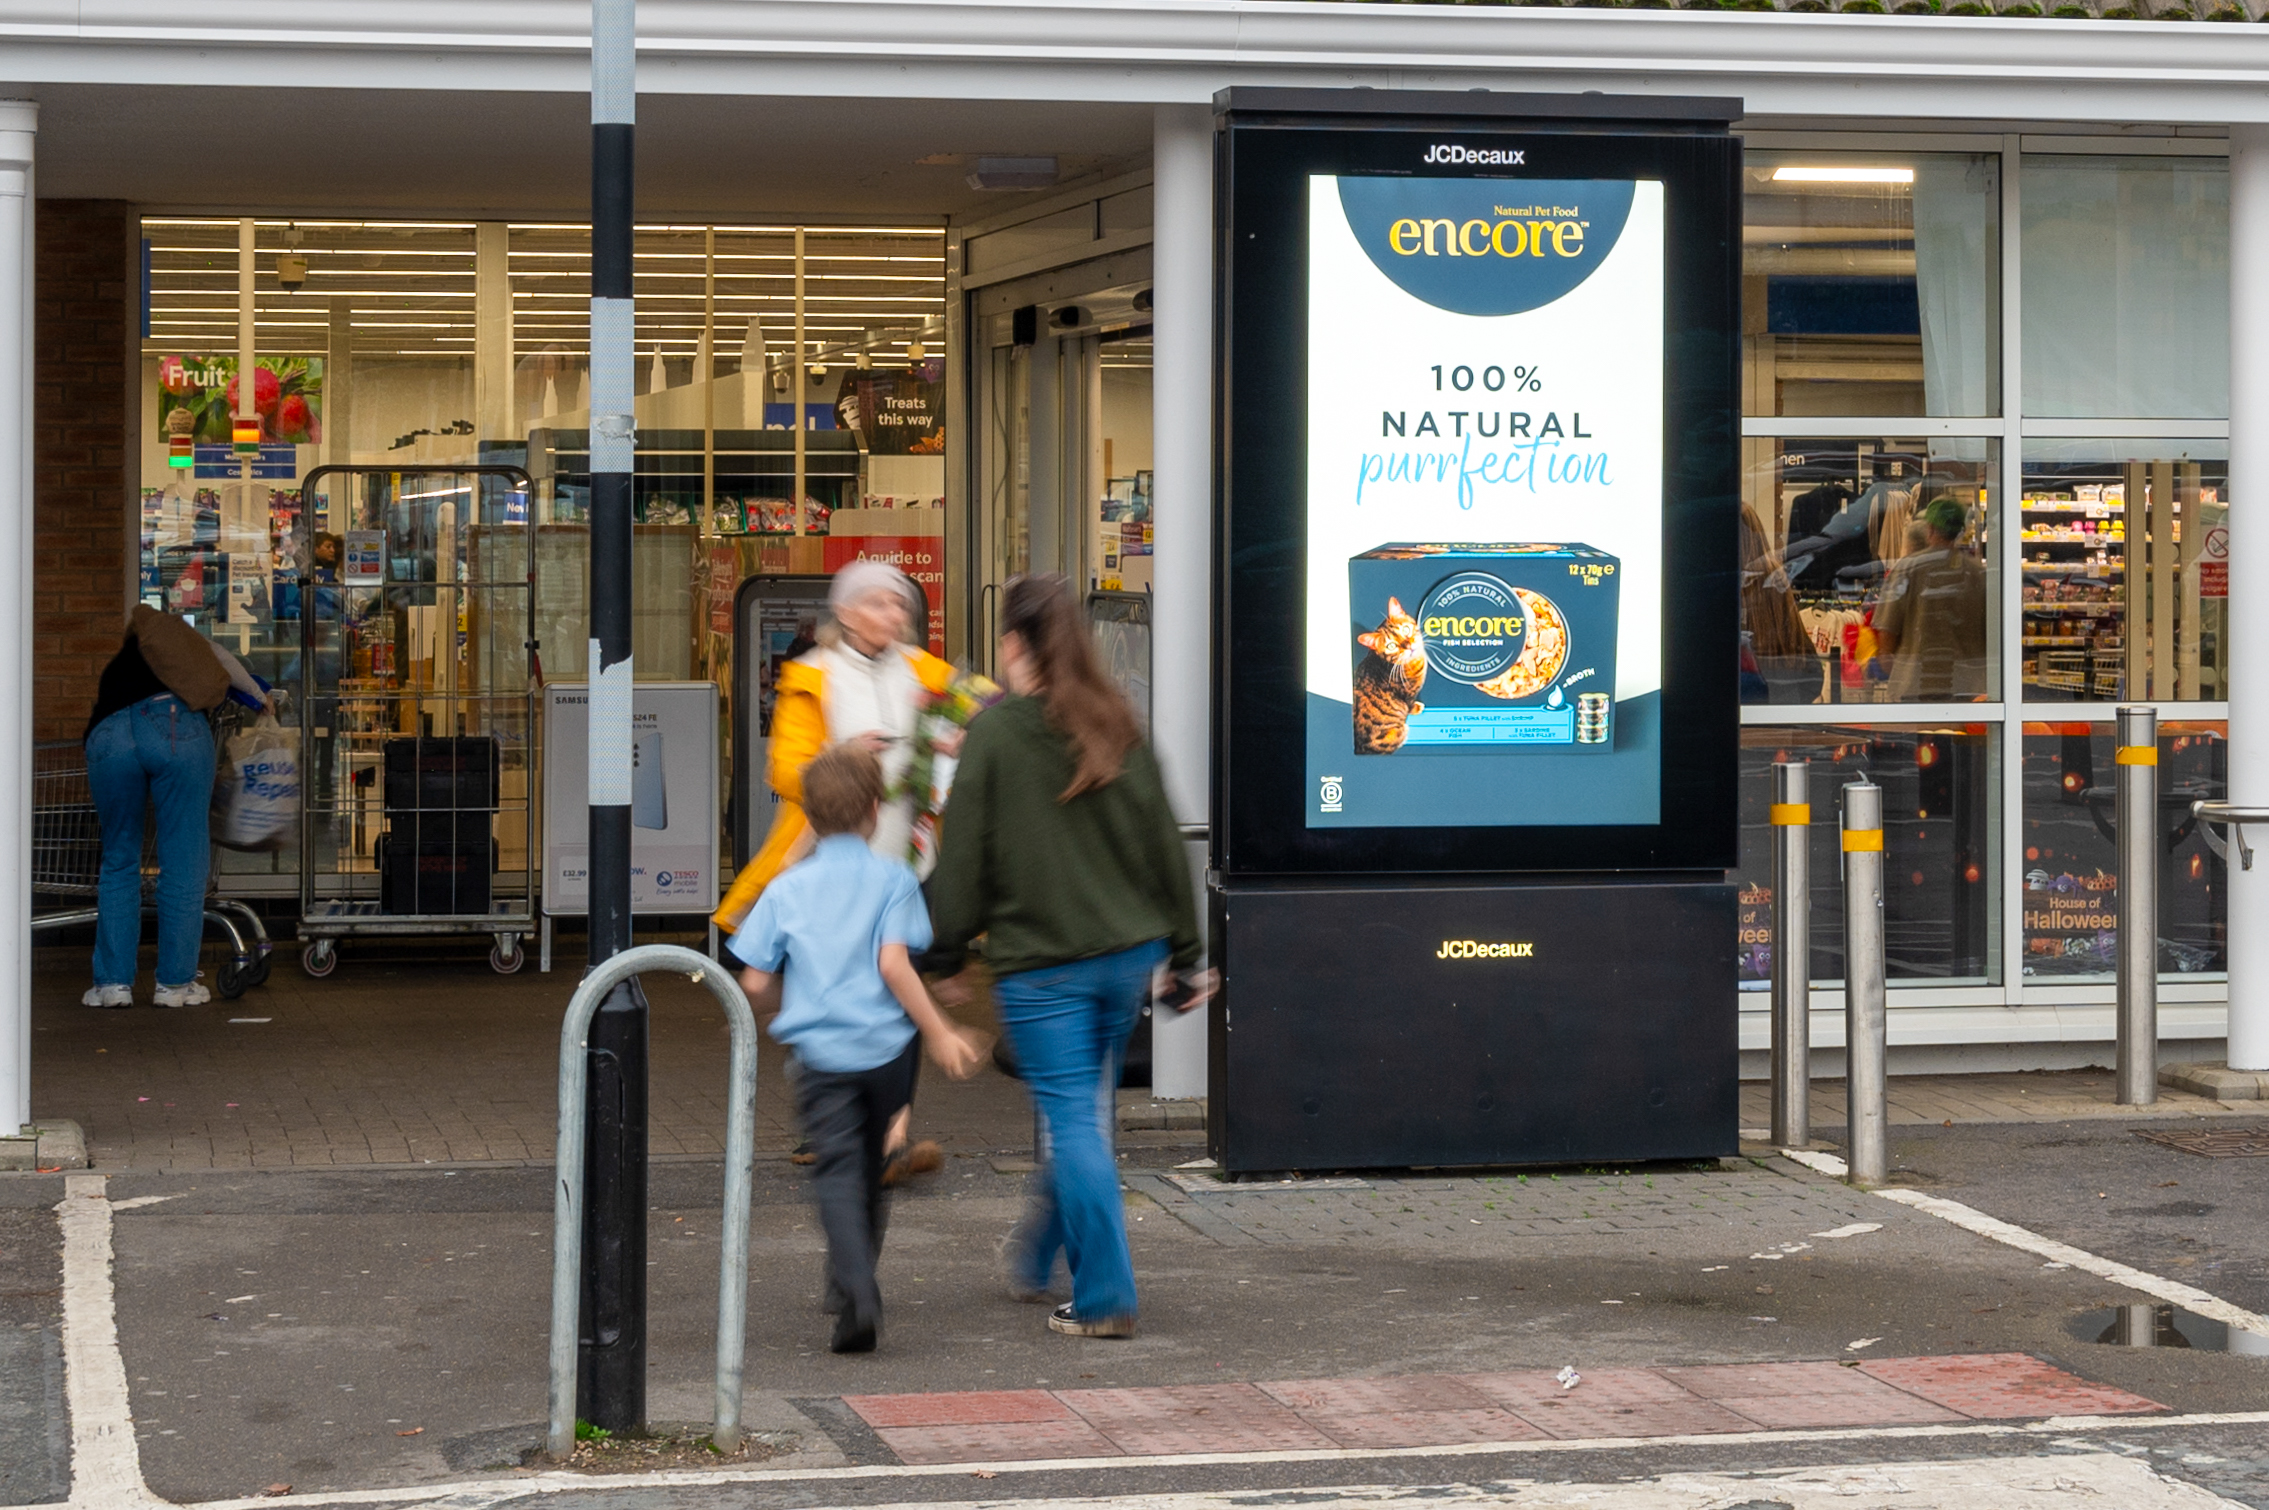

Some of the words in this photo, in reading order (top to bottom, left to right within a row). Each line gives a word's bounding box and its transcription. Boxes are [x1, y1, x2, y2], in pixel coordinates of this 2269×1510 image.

[1424, 145, 1525, 165] JCDecaux
[1494, 205, 1532, 216] Natural
[1535, 207, 1550, 217] Pet
[1553, 206, 1579, 217] Food
[1389, 218, 1584, 258] encore
[168, 365, 227, 387] Fruit
[1431, 365, 1542, 392] 100%
[884, 396, 926, 409] Treats
[878, 413, 903, 425] this
[907, 415, 933, 428] way
[1382, 410, 1592, 438] NATURAL
[1356, 431, 1615, 510] purrfection
[856, 550, 867, 563] A
[916, 552, 932, 565] to
[1569, 565, 1578, 575] 12
[1437, 589, 1460, 608] 100%
[1463, 586, 1506, 608] NATURAL
[1424, 616, 1523, 637] encore
[1445, 657, 1501, 673] INGREDIENTS
[555, 696, 589, 704] SAMSU
[2049, 897, 2086, 908] House
[2089, 896, 2101, 908] of
[1743, 911, 1756, 923] of
[1436, 940, 1534, 959] JCDecaux
